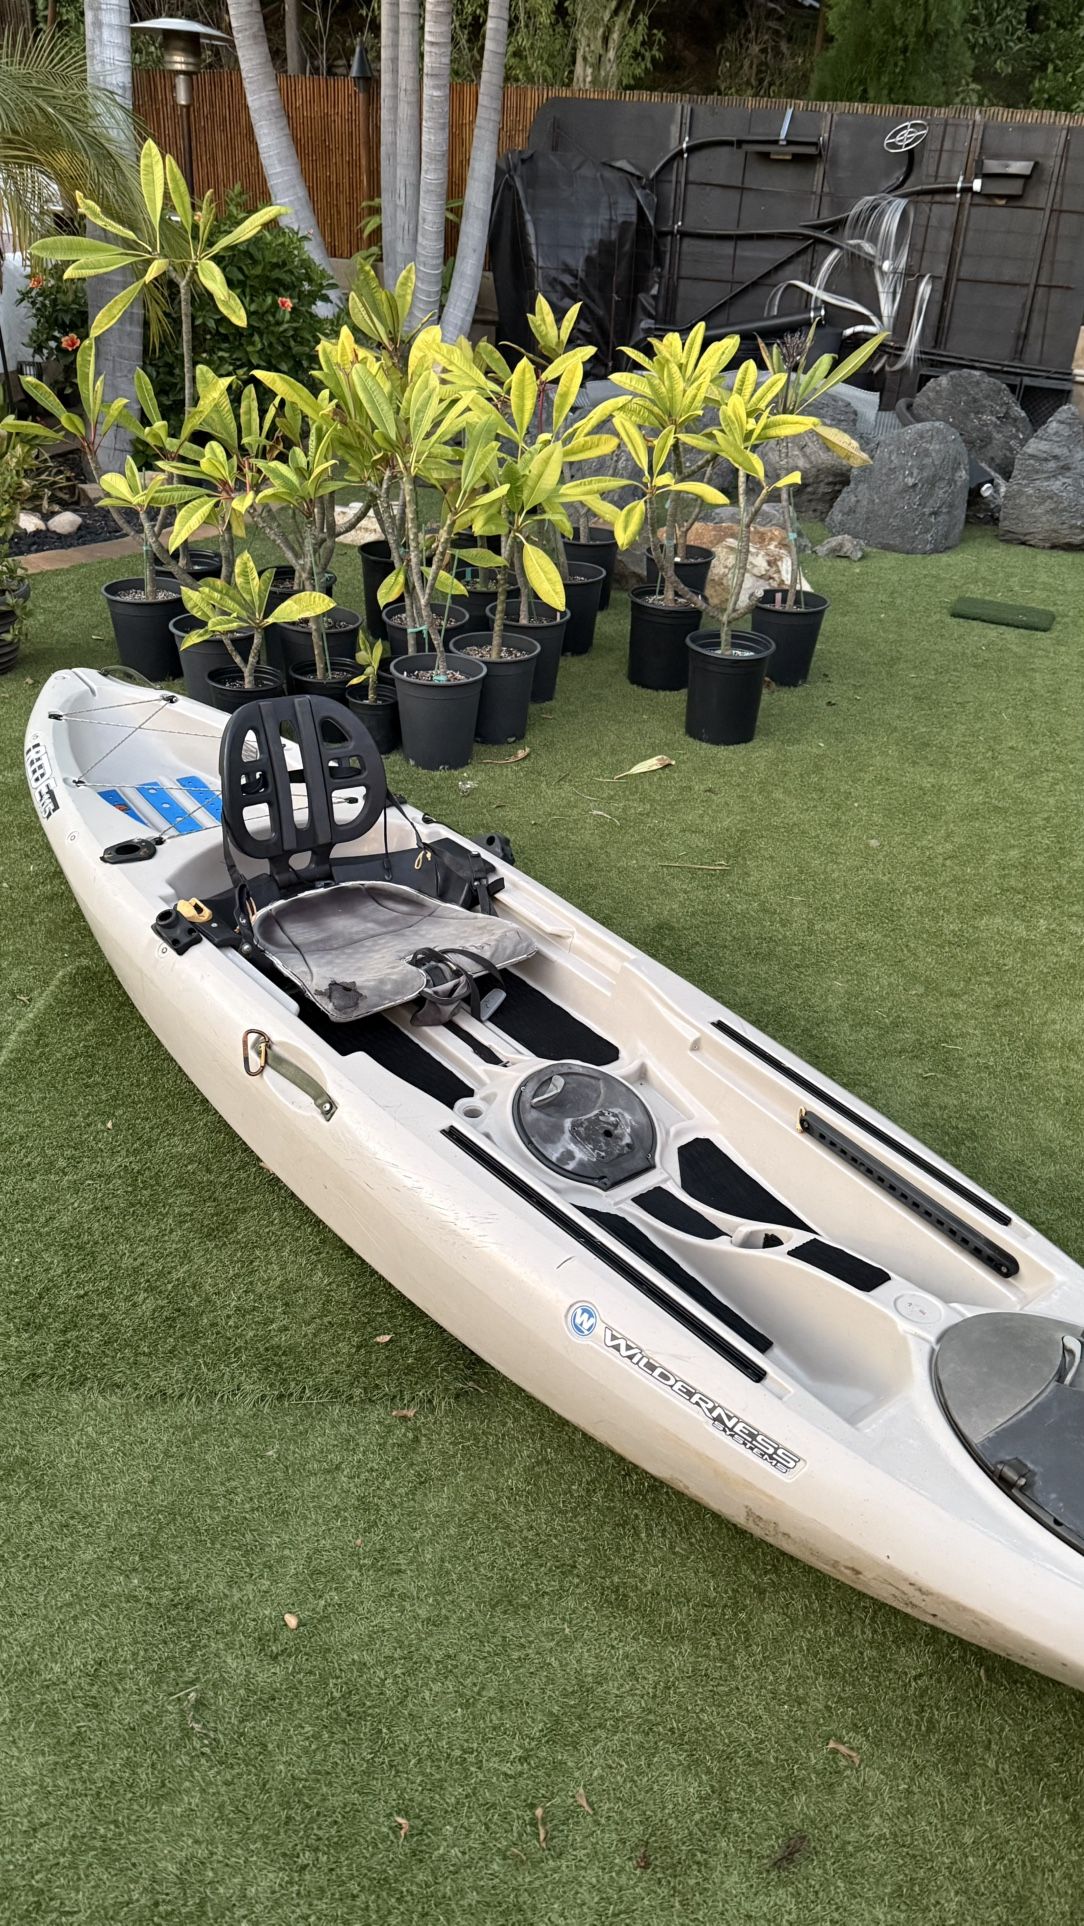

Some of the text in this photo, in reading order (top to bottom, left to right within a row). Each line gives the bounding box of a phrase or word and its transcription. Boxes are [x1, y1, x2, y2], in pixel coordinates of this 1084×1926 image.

[26, 744, 57, 804] RIDE
[573, 1307, 596, 1333] W
[604, 1326, 801, 1470] WILDERNESS
[711, 1420, 788, 1474] SYSTEMS
